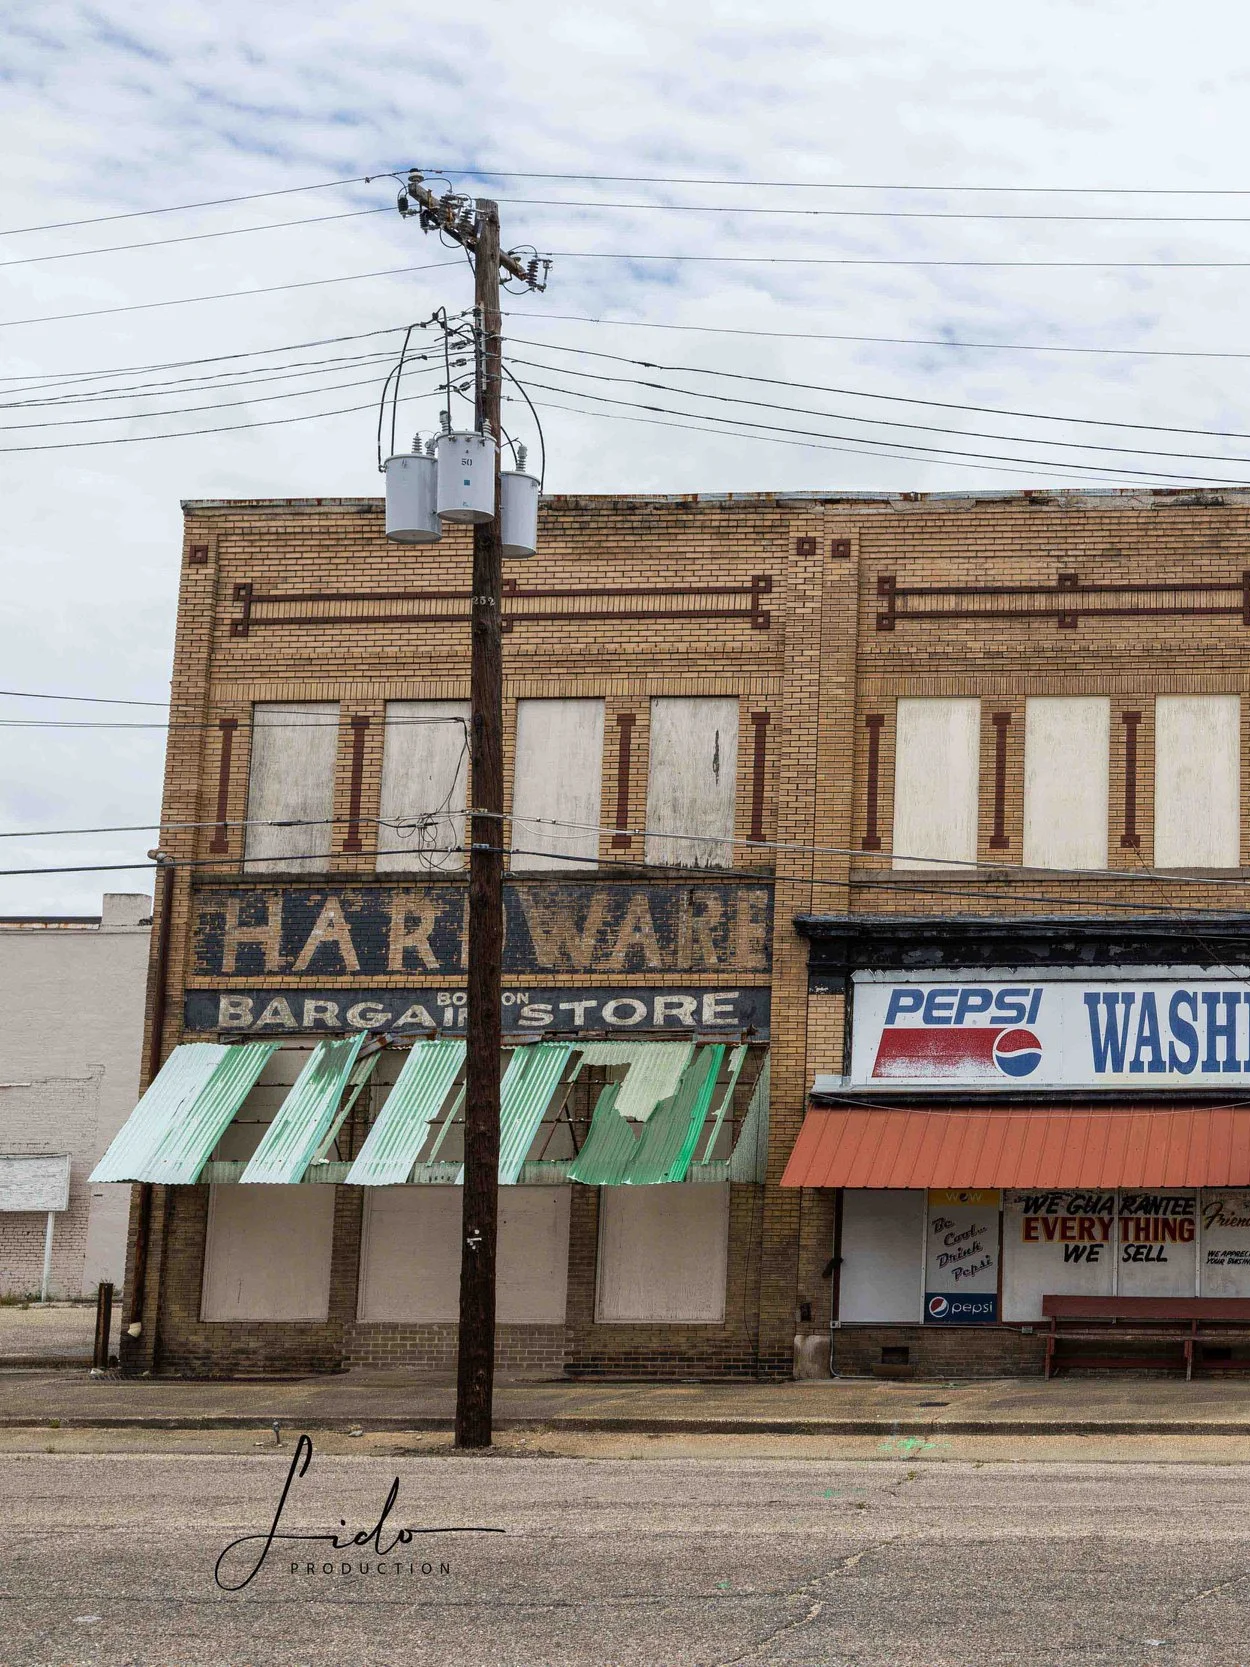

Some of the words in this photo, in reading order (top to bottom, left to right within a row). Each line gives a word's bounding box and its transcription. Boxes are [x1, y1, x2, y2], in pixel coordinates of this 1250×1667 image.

[461, 459, 473, 467] 50
[221, 888, 768, 972] HARWARE
[437, 991, 529, 1006] BOON
[884, 988, 1044, 1025] PEPSI
[518, 991, 740, 1027] STORE
[1022, 1195, 1063, 1215] WE
[932, 1217, 956, 1234] Be
[936, 1240, 984, 1269] Drink
[1064, 1243, 1104, 1263] WE
[1122, 1244, 1168, 1263] SELL
[1207, 1250, 1220, 1258] WE
[951, 1254, 994, 1282] Pepsi
[952, 1301, 993, 1315] pepsi
